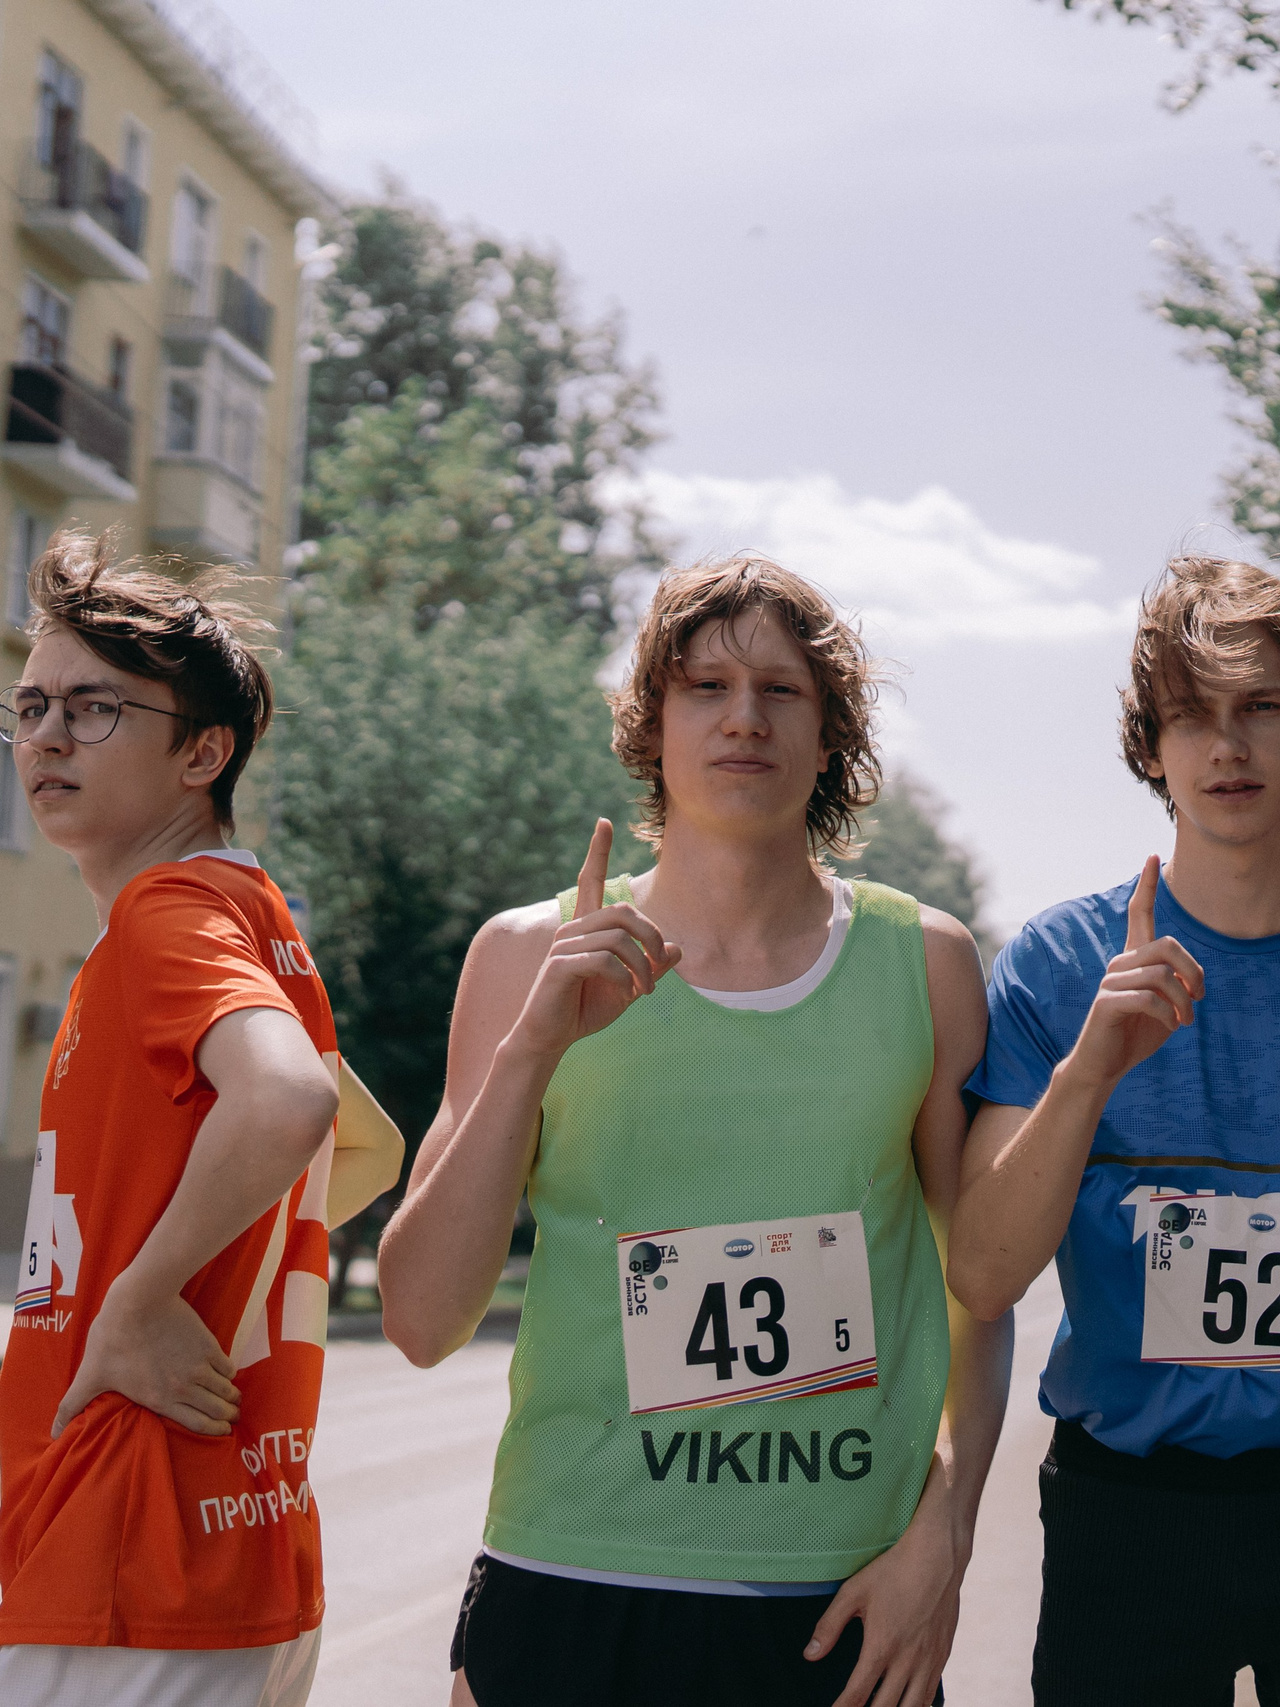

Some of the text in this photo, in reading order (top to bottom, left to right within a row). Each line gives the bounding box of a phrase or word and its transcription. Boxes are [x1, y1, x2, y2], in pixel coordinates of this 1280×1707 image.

[1249, 1218, 1275, 1227] МОТОР
[28, 1241, 38, 1277] 5
[725, 1244, 754, 1253] МОТОР
[685, 1276, 790, 1381] 43
[835, 1317, 851, 1353] 5
[640, 1428, 873, 1484] VIKING
